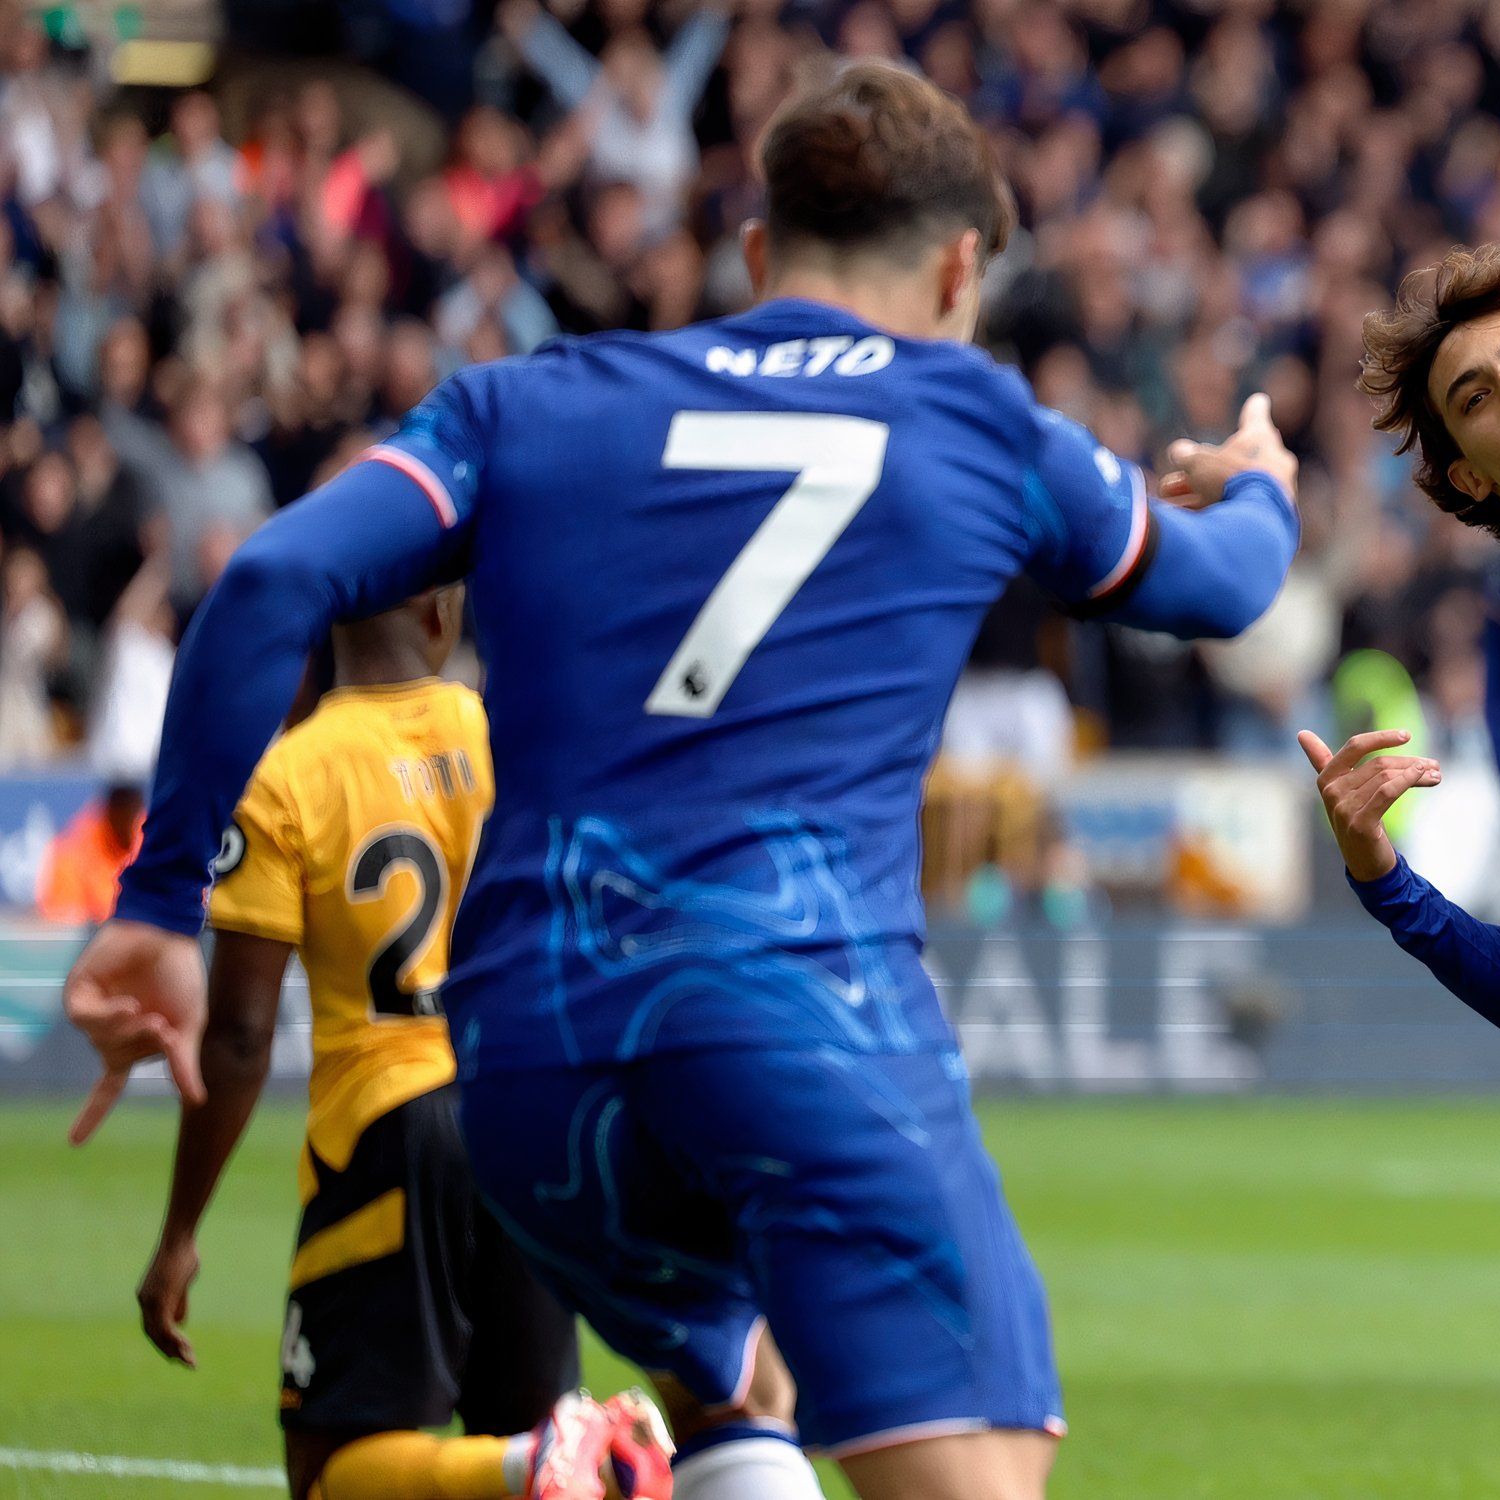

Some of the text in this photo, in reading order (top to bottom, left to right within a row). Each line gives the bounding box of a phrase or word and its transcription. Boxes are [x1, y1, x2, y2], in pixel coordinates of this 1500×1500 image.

[705, 334, 896, 378] NETO
[644, 410, 890, 718] 7
[344, 819, 450, 1023] 2
